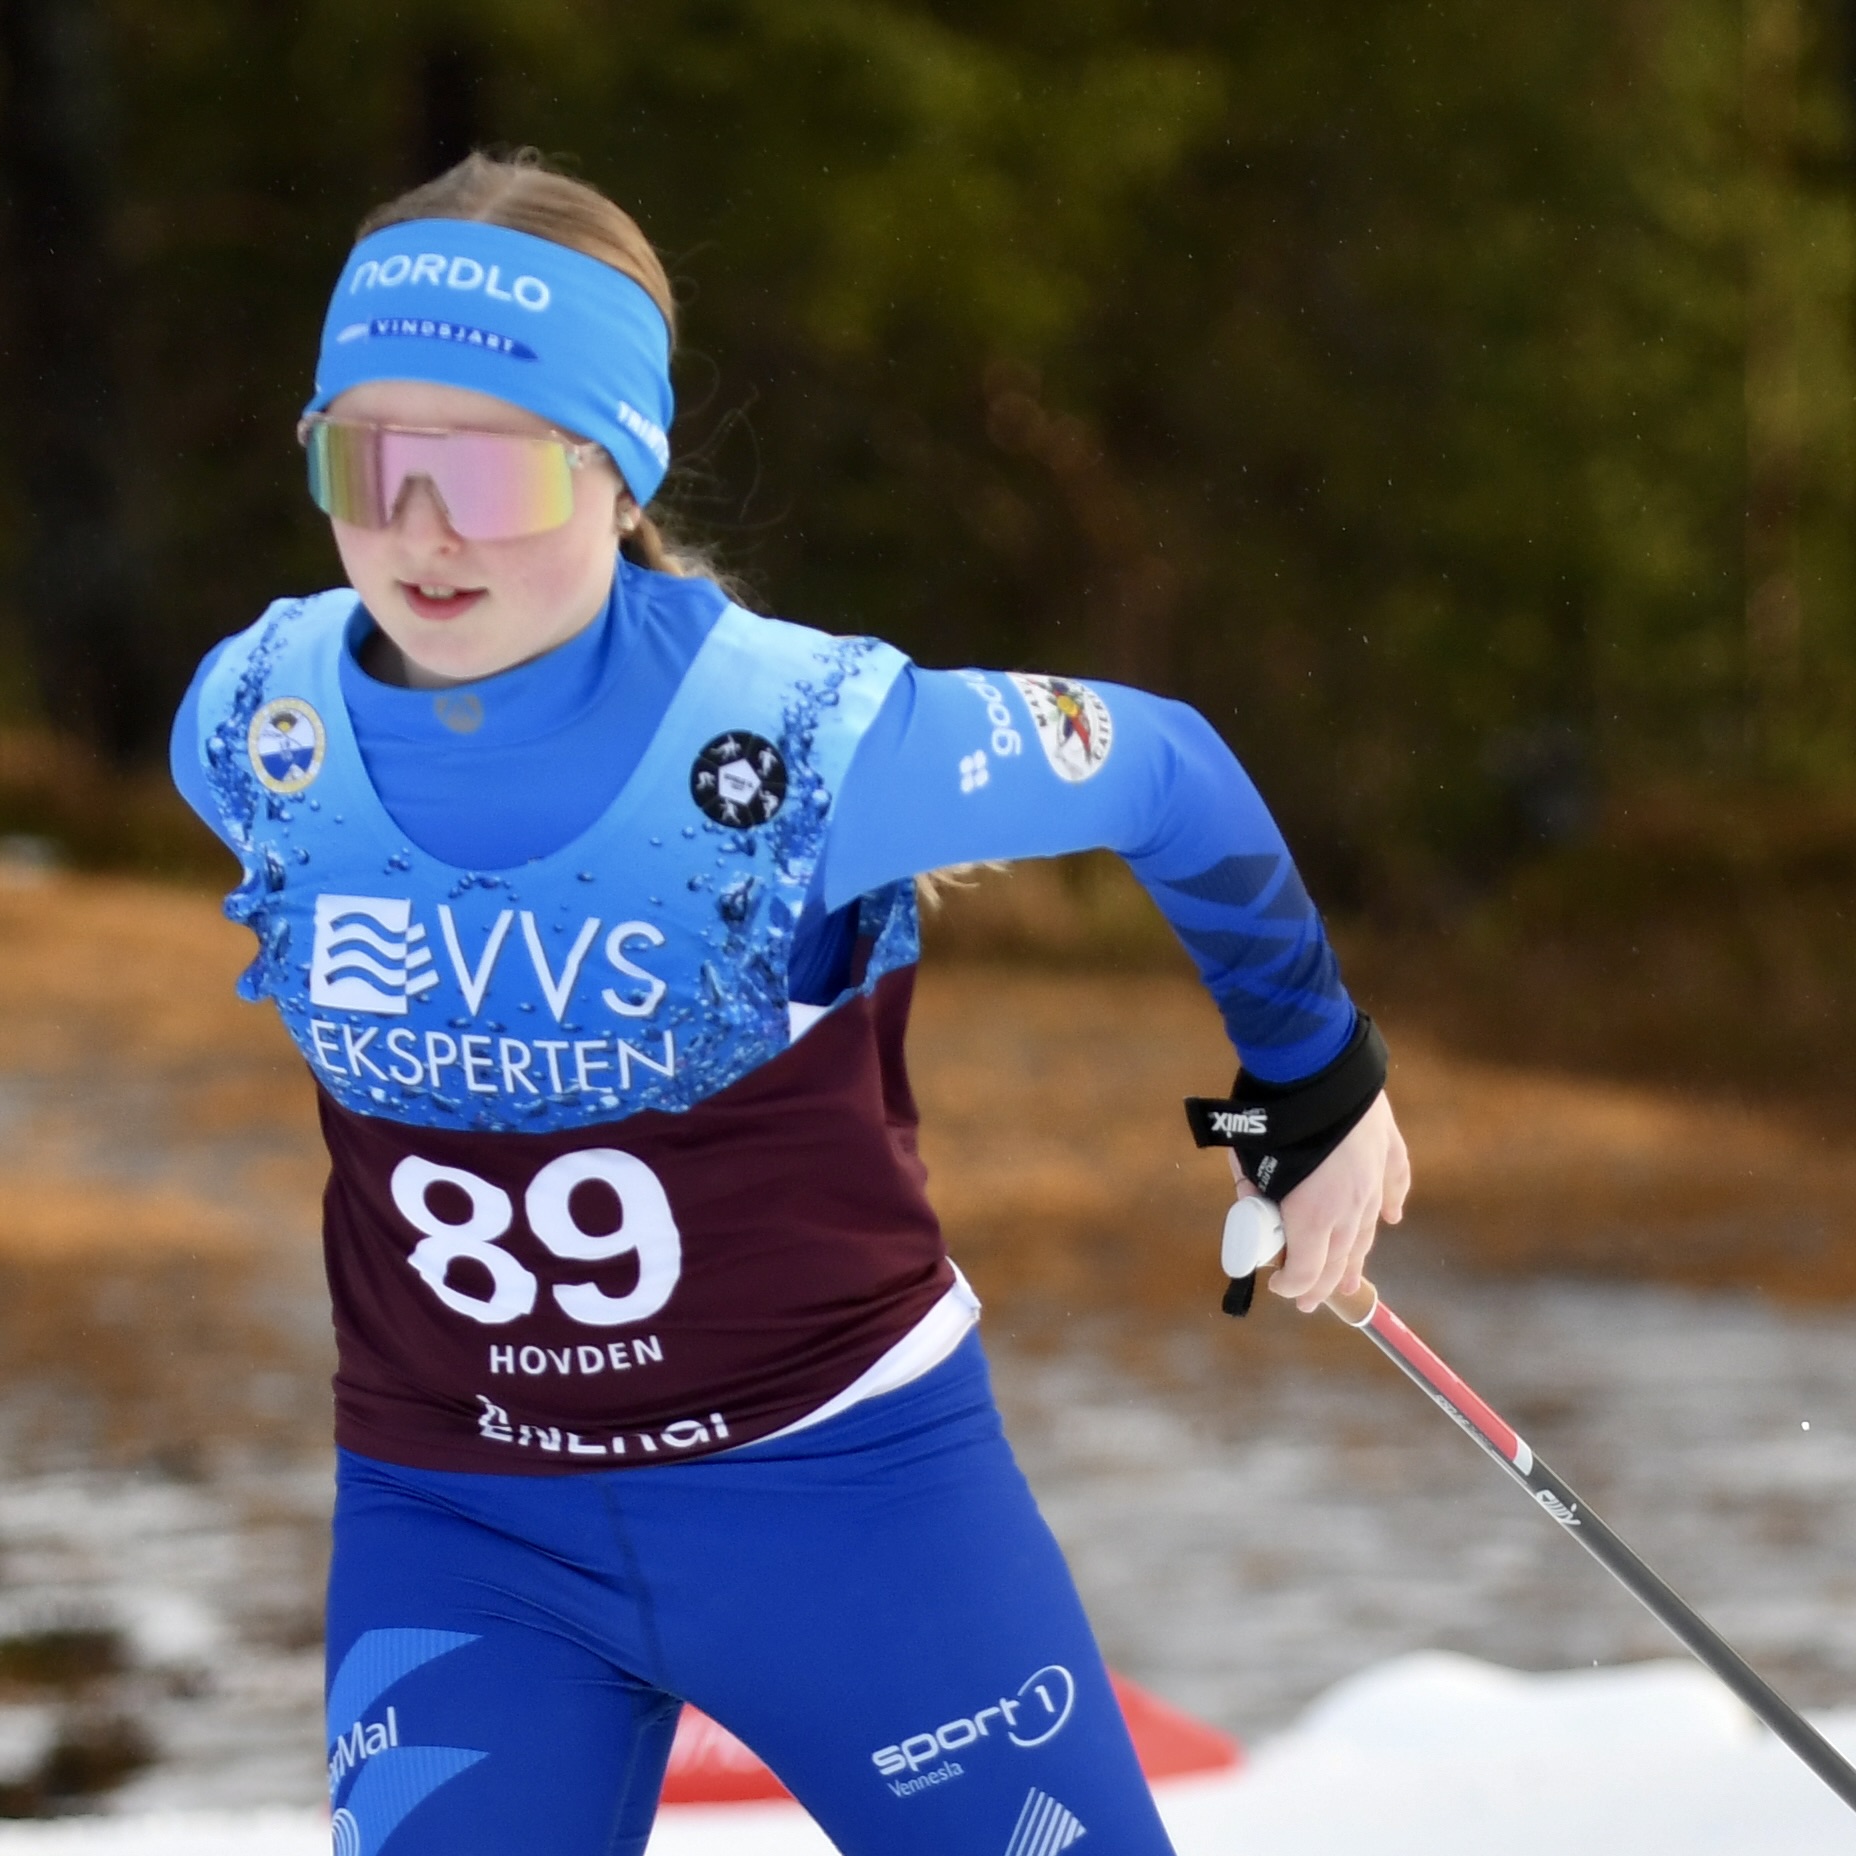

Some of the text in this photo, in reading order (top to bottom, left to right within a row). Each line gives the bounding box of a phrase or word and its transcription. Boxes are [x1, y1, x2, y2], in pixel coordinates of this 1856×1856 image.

[437, 903, 667, 1024] VVS
[309, 1018, 676, 1095] EKSPERTEN
[390, 1147, 682, 1326] 89
[489, 1335, 665, 1376] HOVDEN
[887, 1760, 966, 1798] Vennesla
